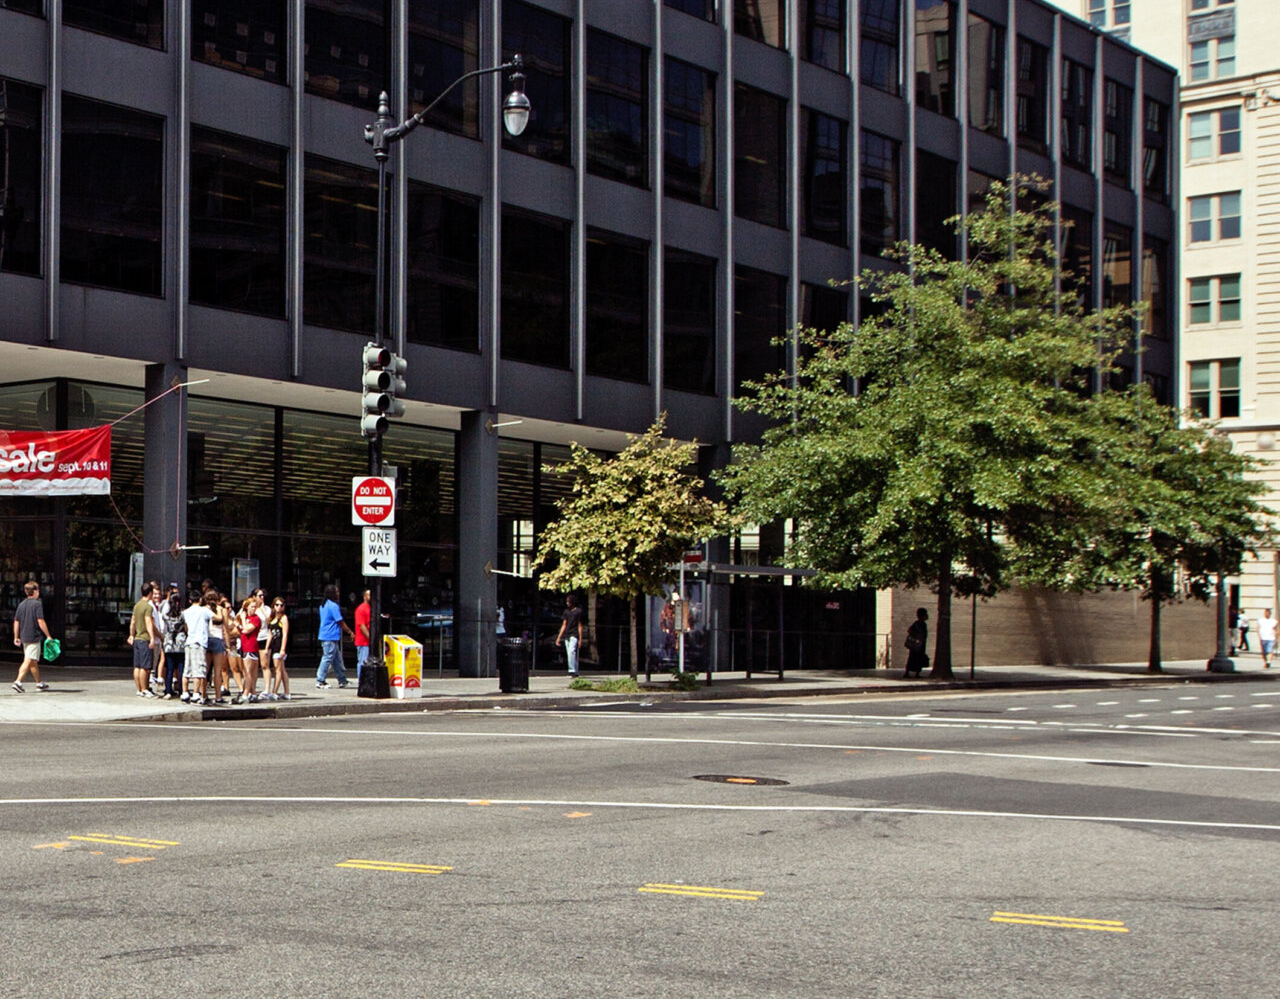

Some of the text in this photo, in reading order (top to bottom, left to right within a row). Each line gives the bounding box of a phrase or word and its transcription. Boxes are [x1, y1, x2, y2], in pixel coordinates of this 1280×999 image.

[58, 461, 108, 475] sept. 10 & 11
[360, 487, 387, 495] DO NOT
[362, 507, 384, 515] ENTER
[369, 532, 391, 543] ONE
[368, 544, 391, 556] WAY
